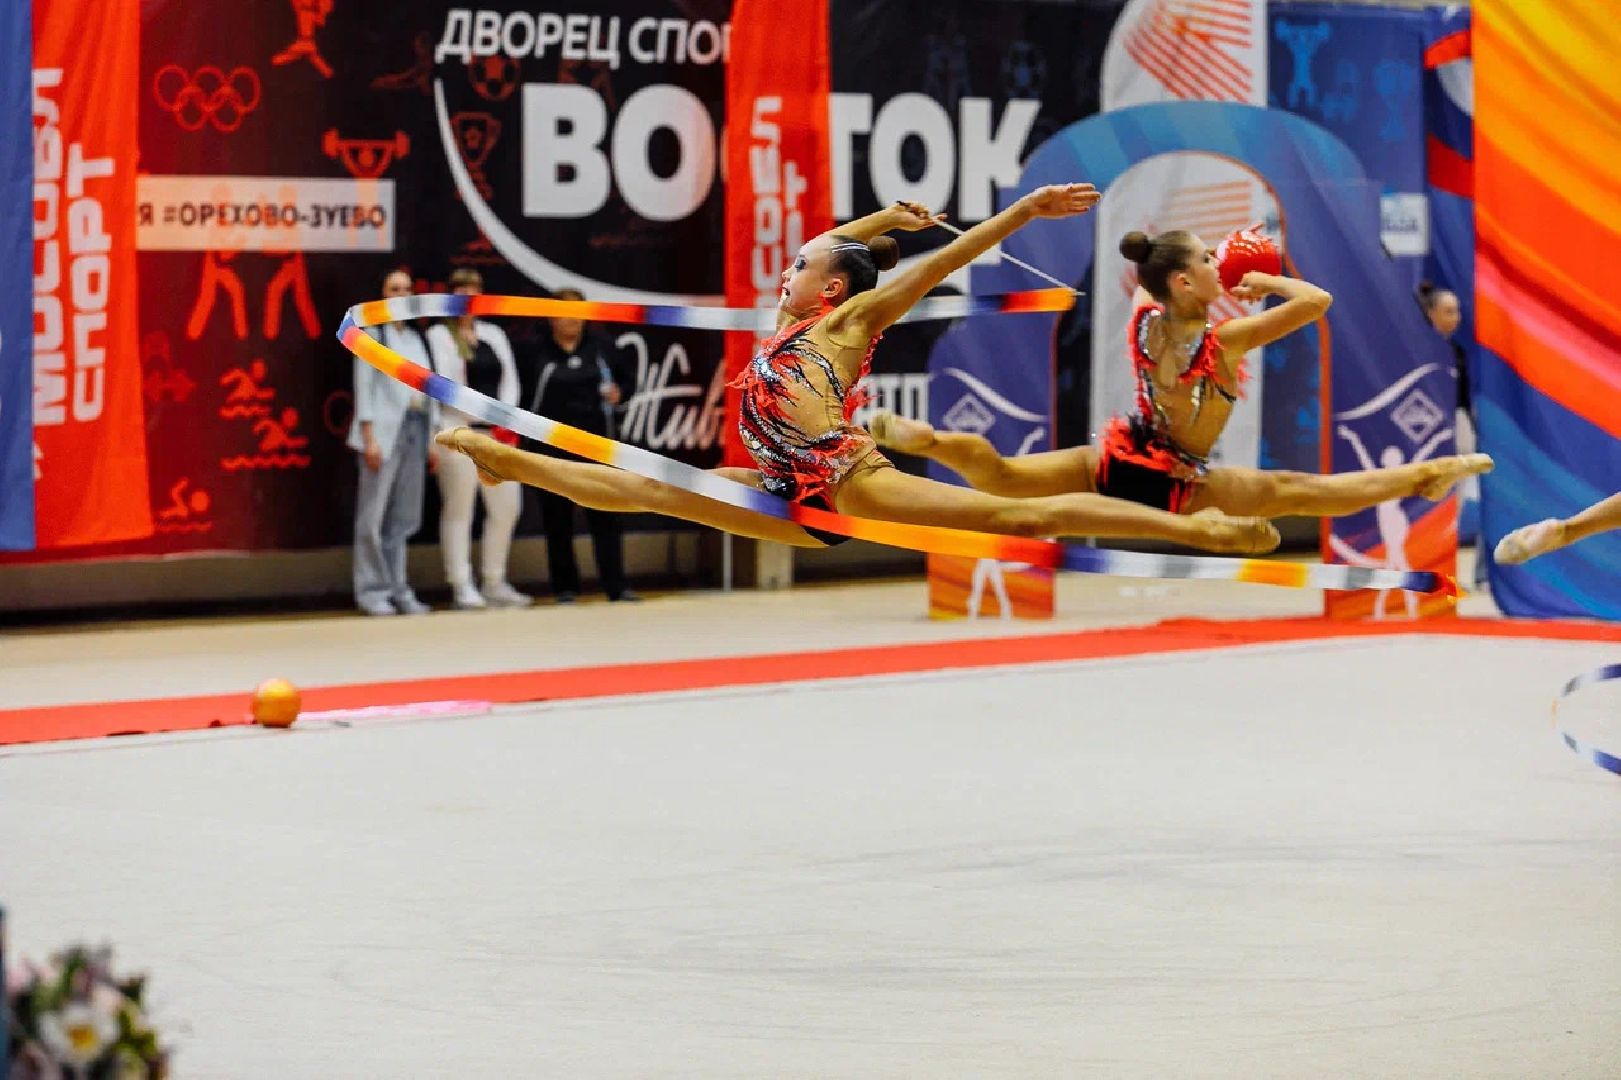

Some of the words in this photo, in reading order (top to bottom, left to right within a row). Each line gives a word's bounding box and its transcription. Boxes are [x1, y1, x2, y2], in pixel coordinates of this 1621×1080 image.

[435, 9, 620, 69] ДВОРЕЦ
[521, 83, 1041, 222] ВОТОК
[67, 142, 115, 422] СПОРТ
